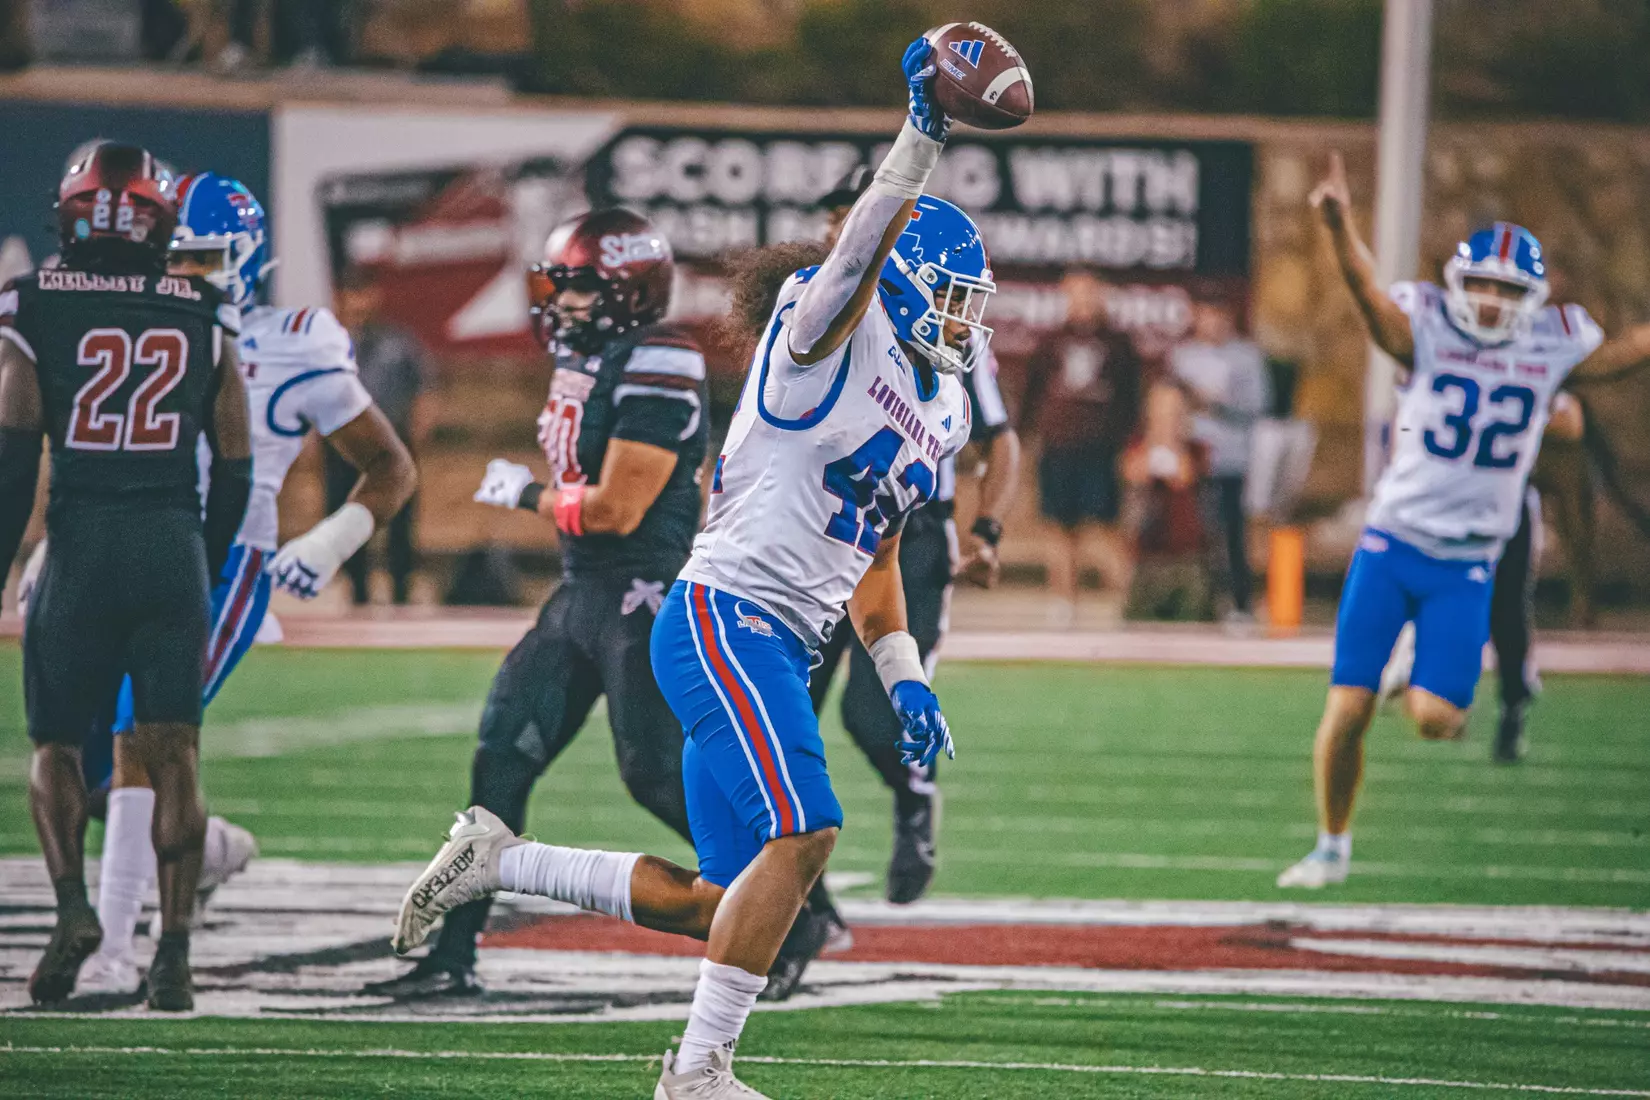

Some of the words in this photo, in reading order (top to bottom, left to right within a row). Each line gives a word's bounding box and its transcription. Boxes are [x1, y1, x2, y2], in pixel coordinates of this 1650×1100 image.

[92, 203, 134, 231] 22
[1008, 147, 1200, 212] WITH
[65, 327, 189, 451] 22
[867, 376, 926, 448] LOUISIANA
[926, 433, 944, 465] TE
[1423, 372, 1536, 468] 32
[822, 424, 938, 556] 42
